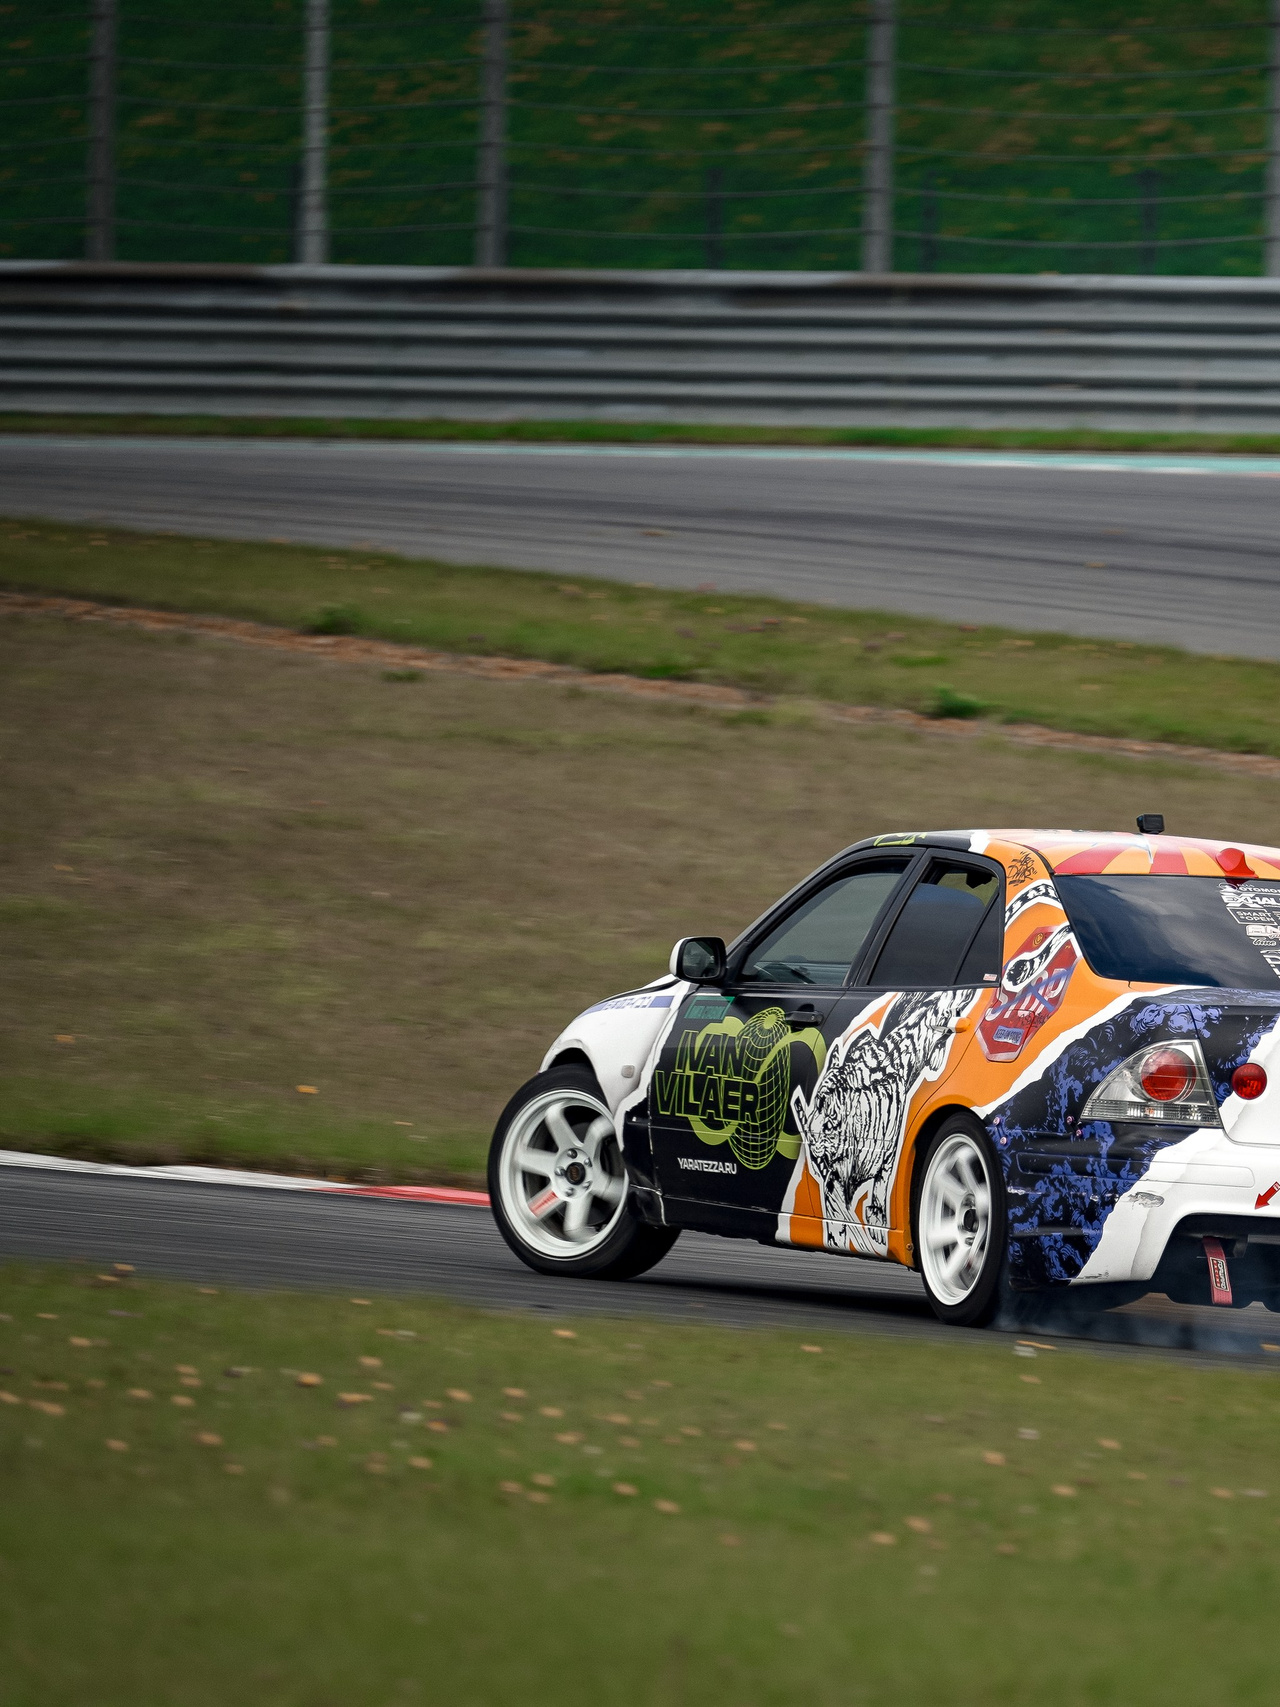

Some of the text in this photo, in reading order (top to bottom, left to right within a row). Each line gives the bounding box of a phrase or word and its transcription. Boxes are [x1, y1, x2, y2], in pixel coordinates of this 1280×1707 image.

[1236, 910, 1272, 918] SMART
[675, 1030, 750, 1080] IVAN
[655, 1070, 760, 1125] VILAER
[677, 1157, 738, 1175] YARATEZZA.RU
